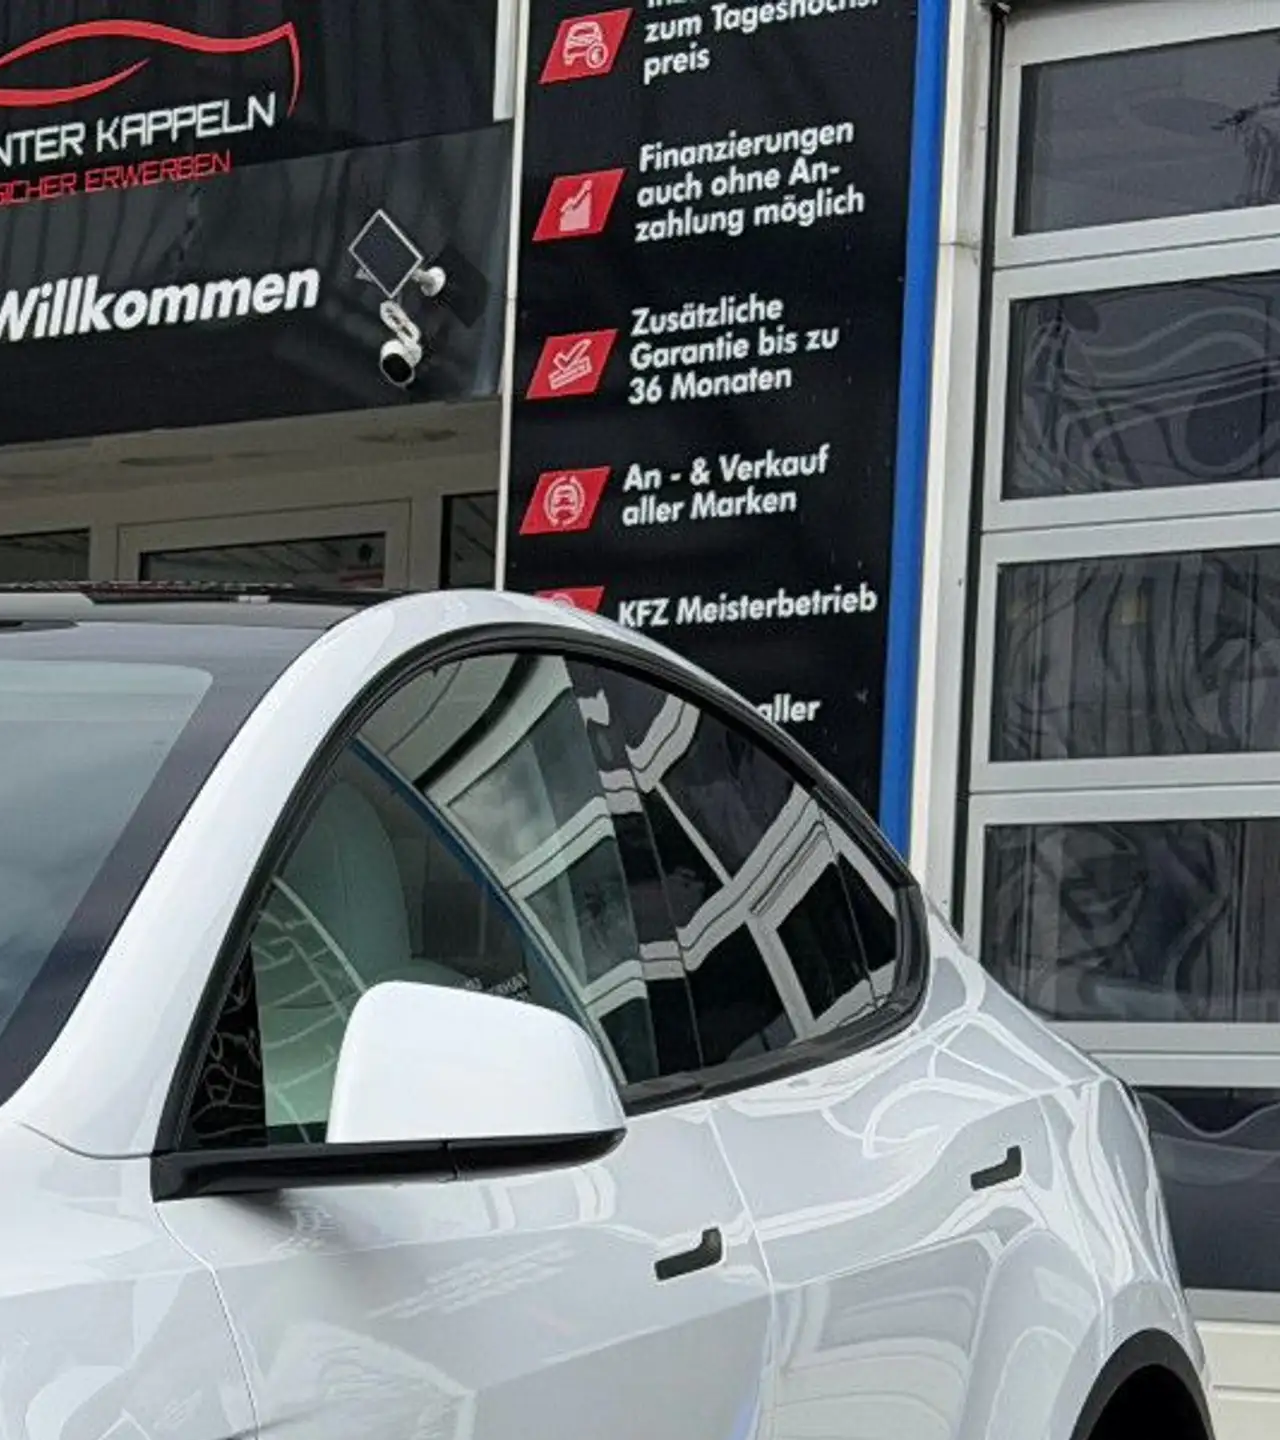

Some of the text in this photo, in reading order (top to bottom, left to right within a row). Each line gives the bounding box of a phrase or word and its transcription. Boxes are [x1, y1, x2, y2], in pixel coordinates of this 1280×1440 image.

[644, 13, 702, 44] zum
[643, 42, 710, 85] preis
[96, 91, 276, 153] KAPPELN
[639, 121, 854, 172] Finanzierungen
[84, 149, 231, 193] ERWERBEN
[637, 156, 841, 208] auch ohne An-
[635, 183, 864, 243] zahlung möglich
[630, 293, 784, 337] Zusätzliche
[629, 324, 840, 370] Garantie bis zu
[628, 366, 792, 405] 36 Monaten
[622, 463, 662, 493] An
[690, 457, 712, 486] &
[718, 443, 831, 482] Verkauf
[622, 485, 798, 527] aller Marken
[618, 582, 878, 628] KFZ Meisterbetrieb
